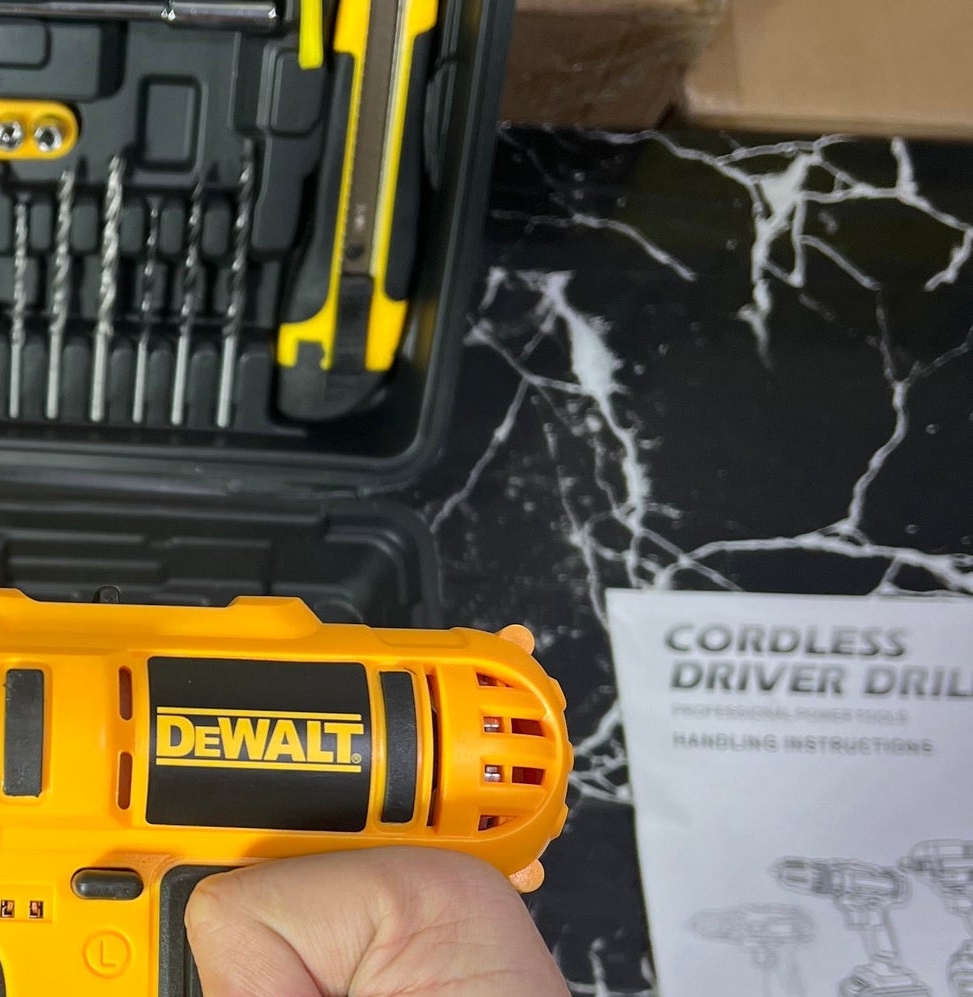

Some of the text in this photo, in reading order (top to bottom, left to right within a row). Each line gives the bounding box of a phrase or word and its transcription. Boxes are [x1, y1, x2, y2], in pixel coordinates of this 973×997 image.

[665, 624, 907, 658] CORDLESS
[670, 660, 973, 698] DRIVER DRIL
[673, 732, 933, 756] HANDLING INSTRUCTIONS
